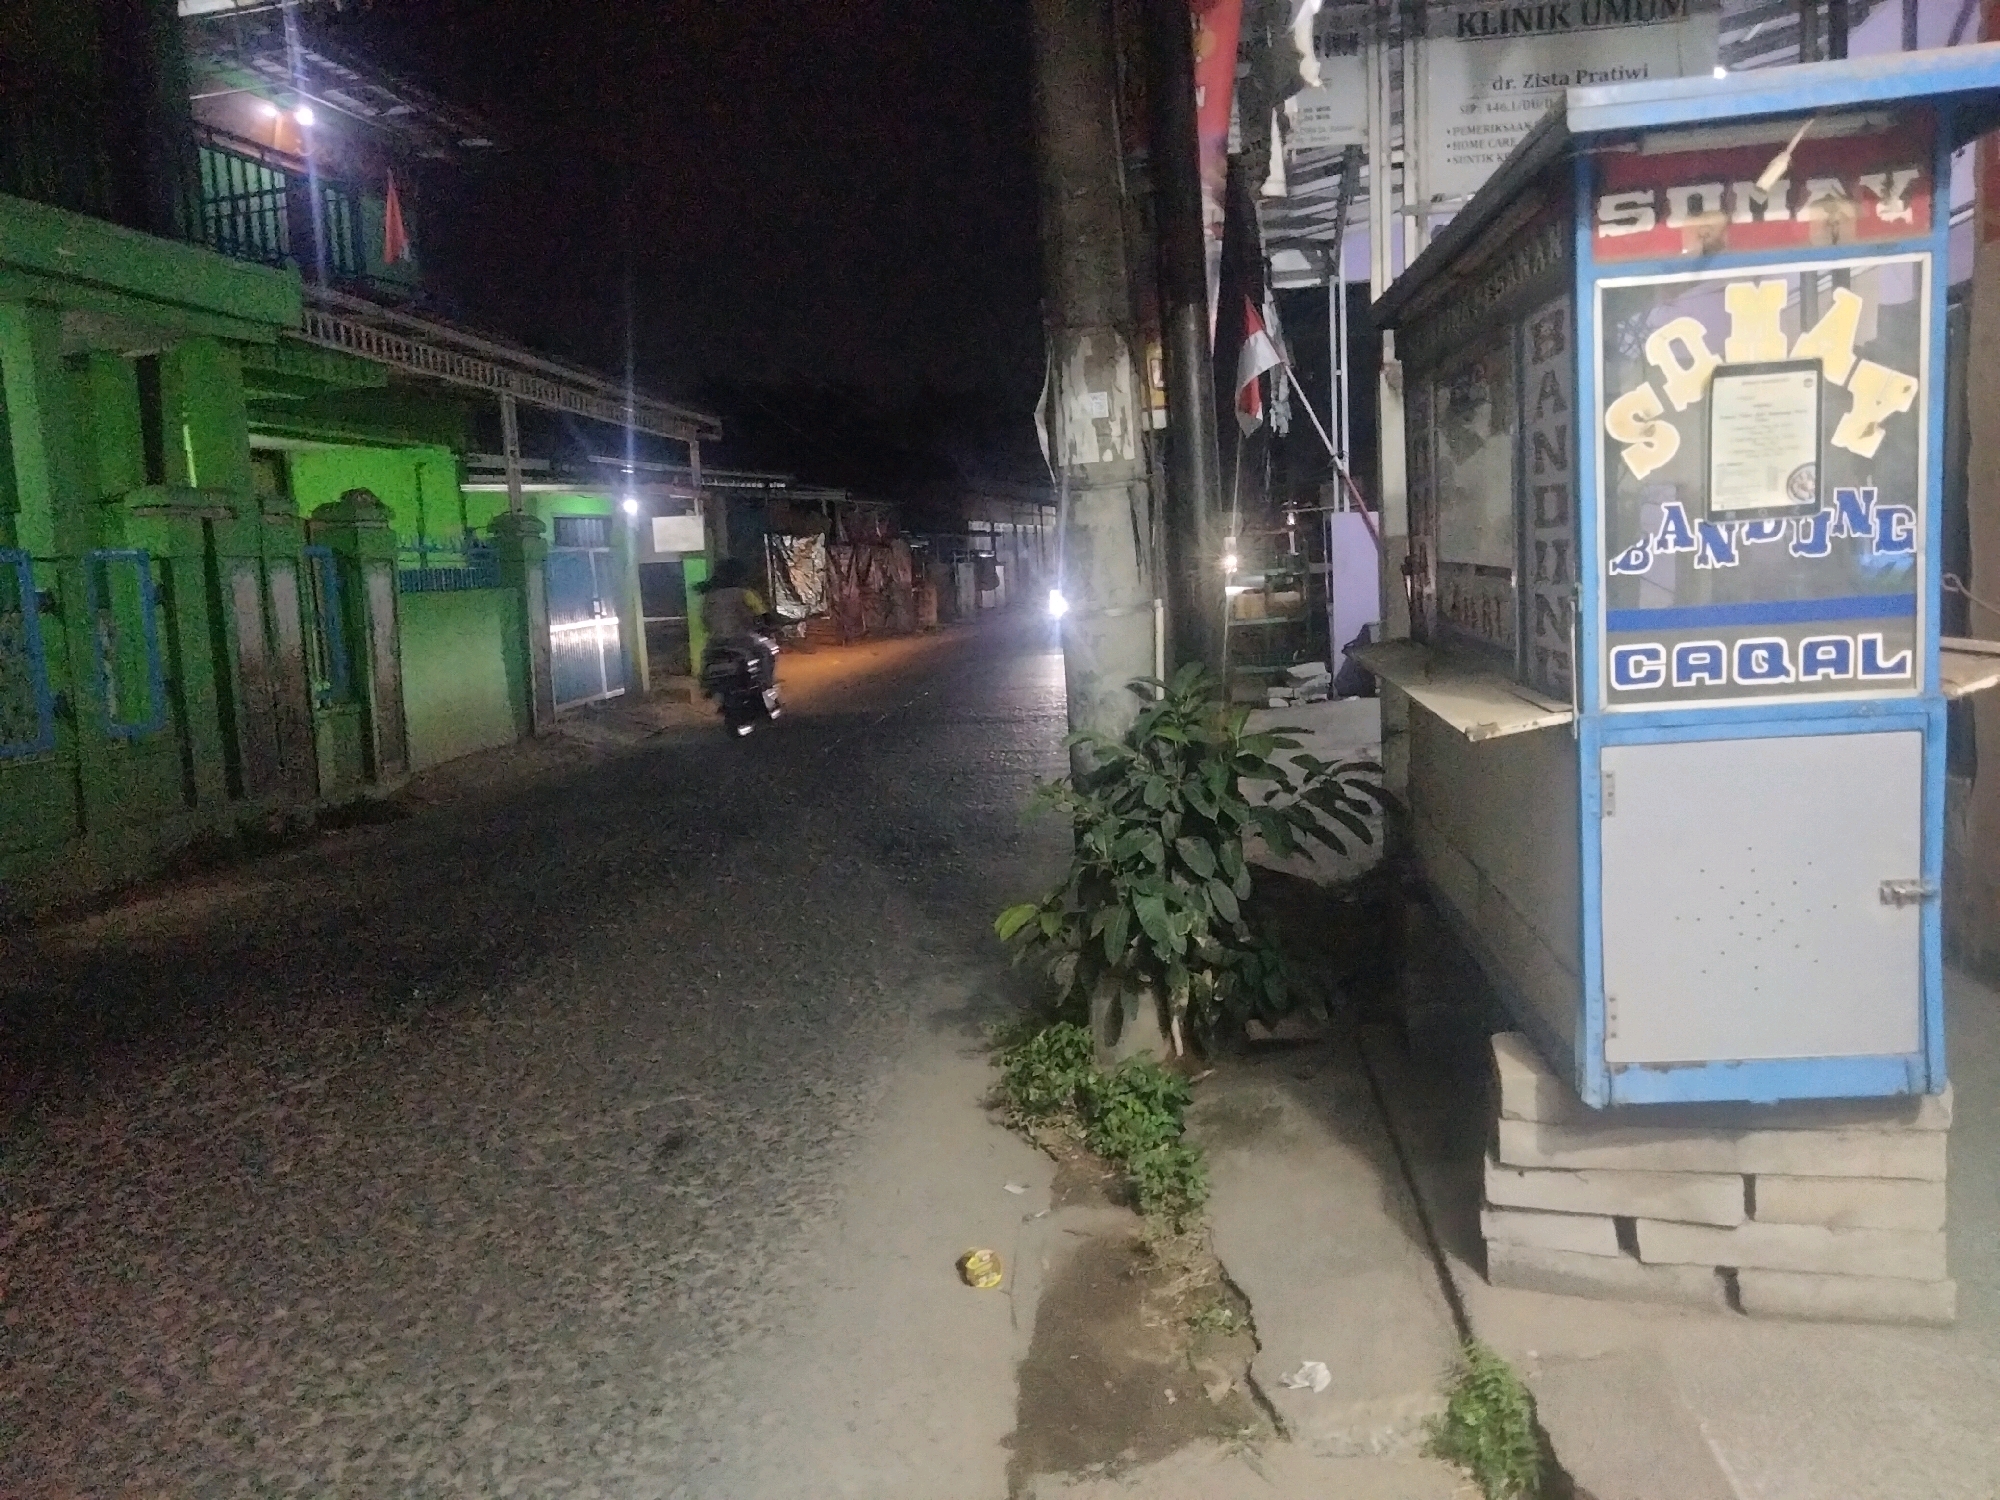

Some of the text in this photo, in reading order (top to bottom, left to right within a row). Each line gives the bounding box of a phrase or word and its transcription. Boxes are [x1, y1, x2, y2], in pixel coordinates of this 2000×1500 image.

[1456, 0, 1689, 38] KLINIK UMUM
[1491, 63, 1650, 91] dr. Zista Pratiwi
[1605, 278, 1920, 480] SOMAY
[1609, 632, 1913, 691] CAQAL
